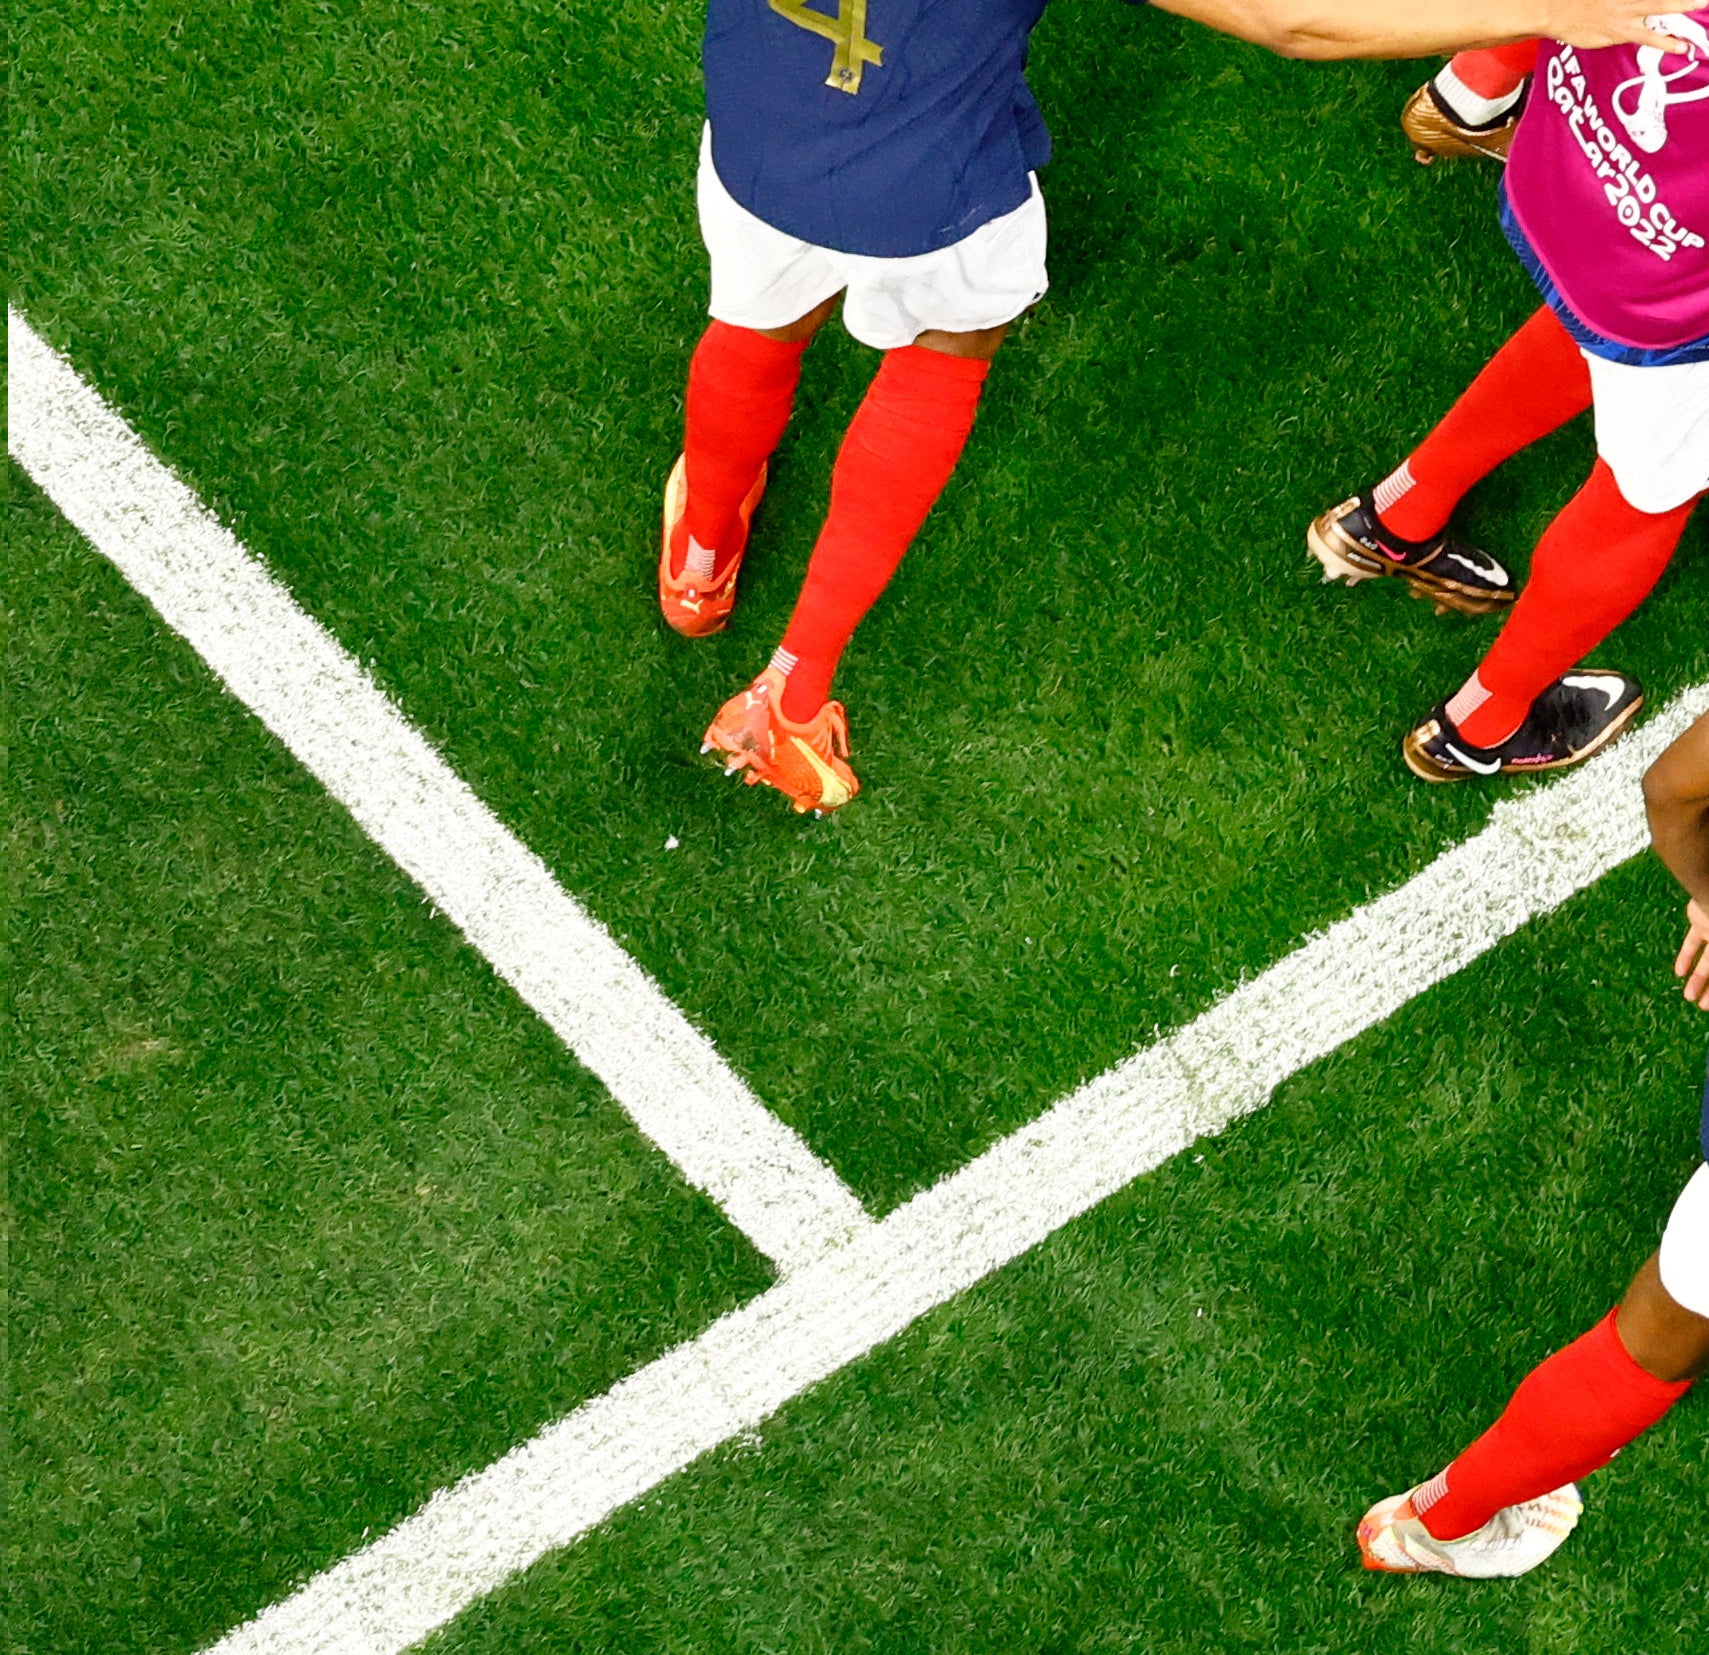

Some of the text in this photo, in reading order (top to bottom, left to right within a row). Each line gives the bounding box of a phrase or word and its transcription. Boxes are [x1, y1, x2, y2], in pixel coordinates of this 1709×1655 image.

[1559, 43, 1705, 248] IFA WORLD CUP
